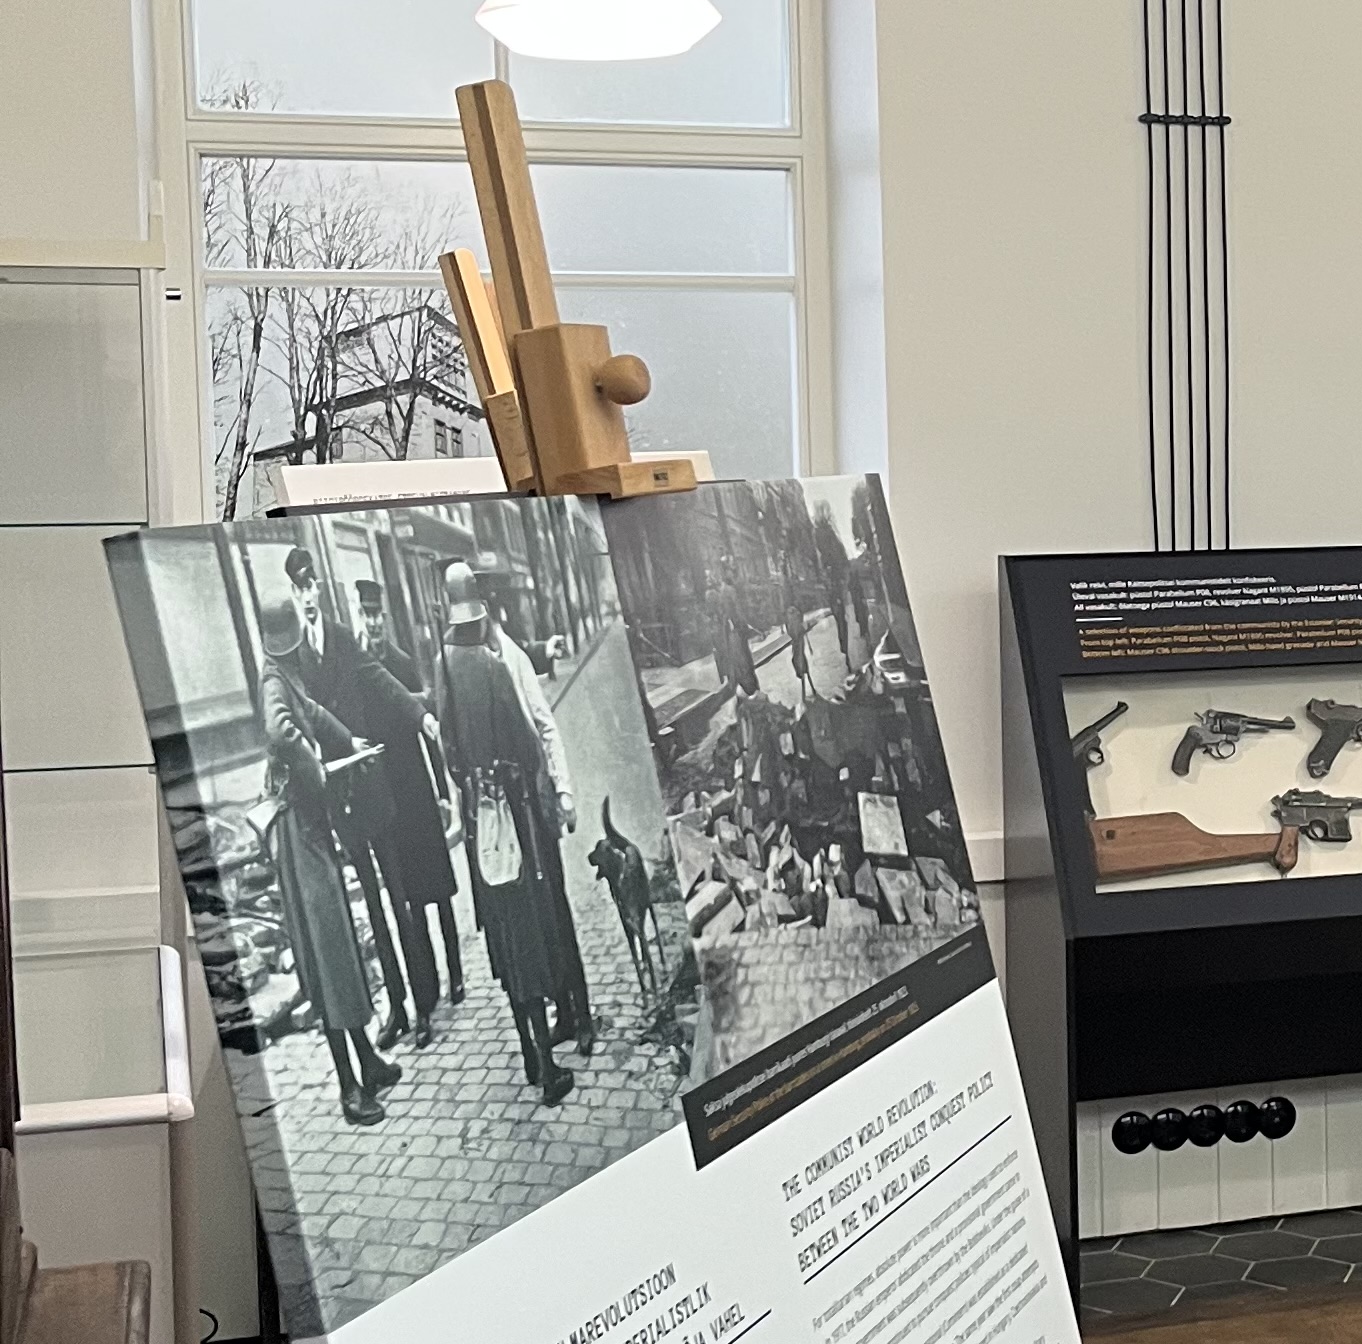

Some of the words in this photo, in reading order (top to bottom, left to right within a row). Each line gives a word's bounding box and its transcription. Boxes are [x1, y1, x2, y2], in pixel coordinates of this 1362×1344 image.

[781, 1172, 802, 1203] THE
[804, 1135, 855, 1186] COMMUNIST
[855, 1115, 885, 1149] WORLD
[789, 1195, 826, 1238] SOVIET
[827, 1161, 873, 1210] RUSSIA'S
[873, 1119, 929, 1174] IMPERIALIST
[929, 1091, 967, 1132] CONQUEST
[966, 1070, 994, 1104] POLICY
[797, 1225, 840, 1273] BETWEEN
[840, 1209, 861, 1239] THE
[861, 1194, 880, 1223] TWO
[880, 1172, 909, 1207] WORLD
[908, 1154, 931, 1184] WARS
[708, 1302, 746, 1342] VAHEL
